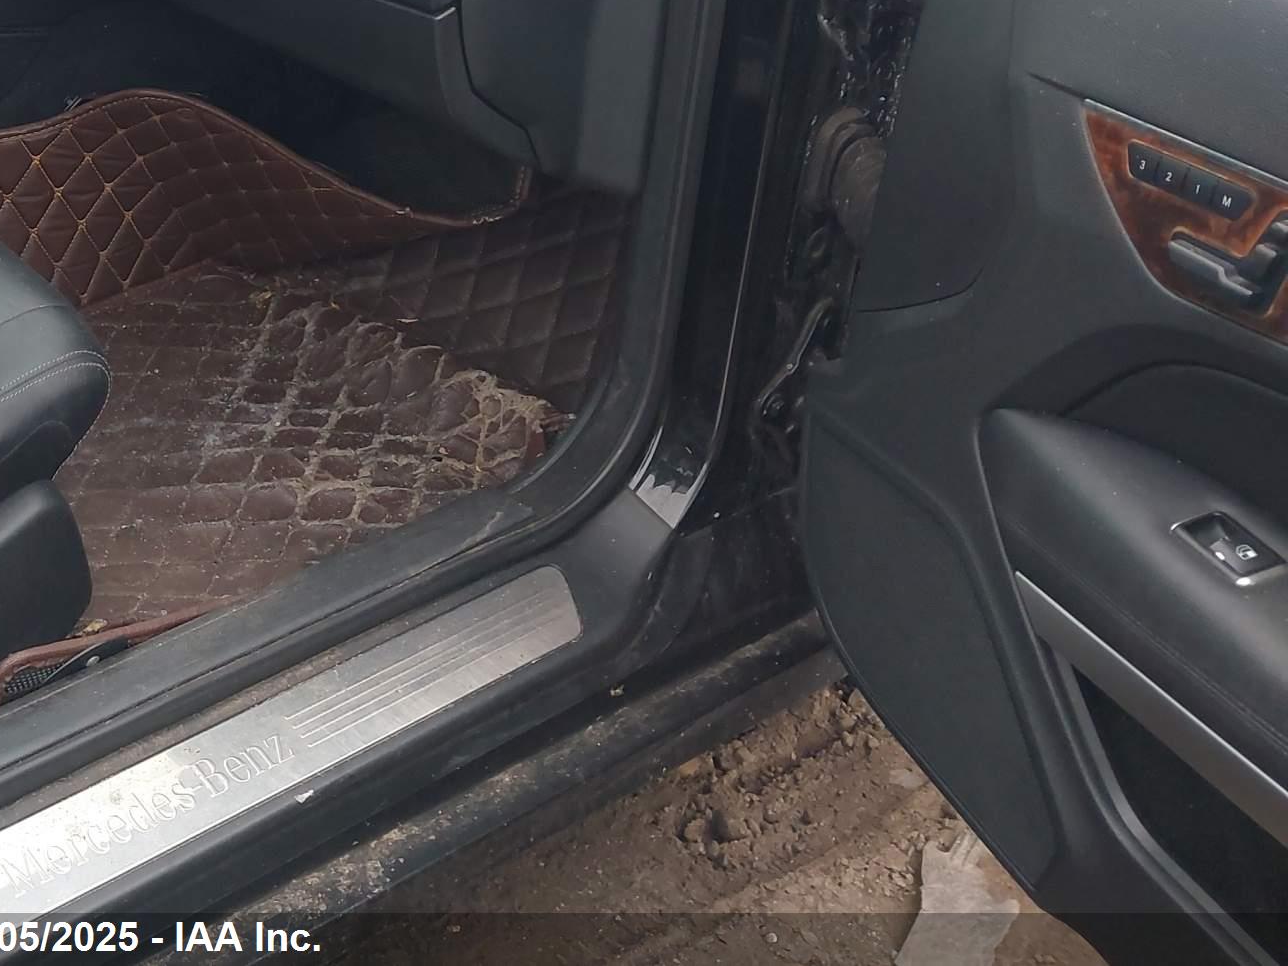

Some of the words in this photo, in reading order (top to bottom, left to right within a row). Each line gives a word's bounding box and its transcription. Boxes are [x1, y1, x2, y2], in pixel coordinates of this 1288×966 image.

[1139, 160, 1146, 170] 3
[1165, 172, 1173, 182] 2
[1194, 184, 1201, 195] 1
[1222, 196, 1232, 208] M
[0, 733, 296, 898] Mercedes-Benz
